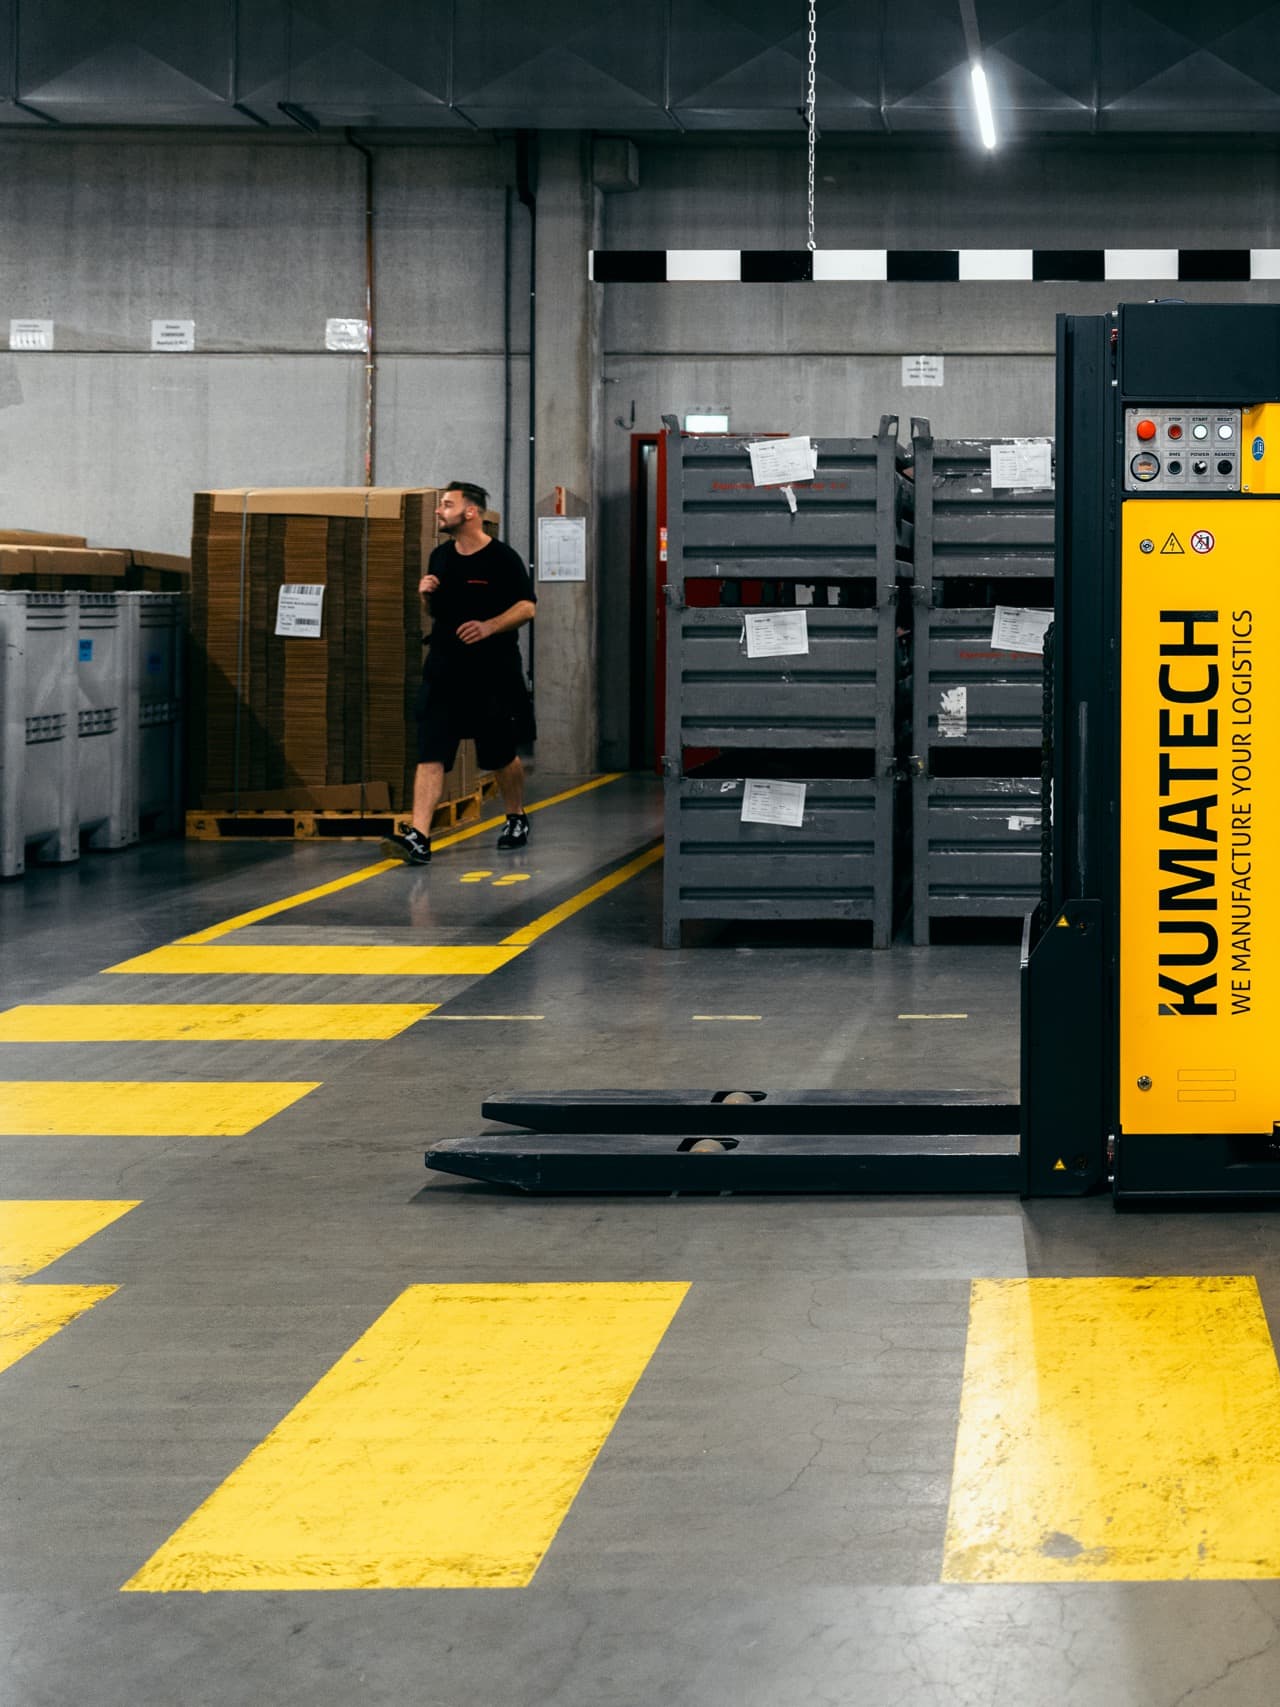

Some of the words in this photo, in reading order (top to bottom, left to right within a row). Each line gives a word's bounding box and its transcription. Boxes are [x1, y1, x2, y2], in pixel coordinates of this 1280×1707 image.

[1231, 610, 1253, 725] LOGISTICS
[1159, 610, 1219, 1016] KUMATECH
[1231, 733, 1253, 796] YOUR
[1231, 803, 1252, 972] MANUFACTURE
[1231, 979, 1252, 1016] WE
